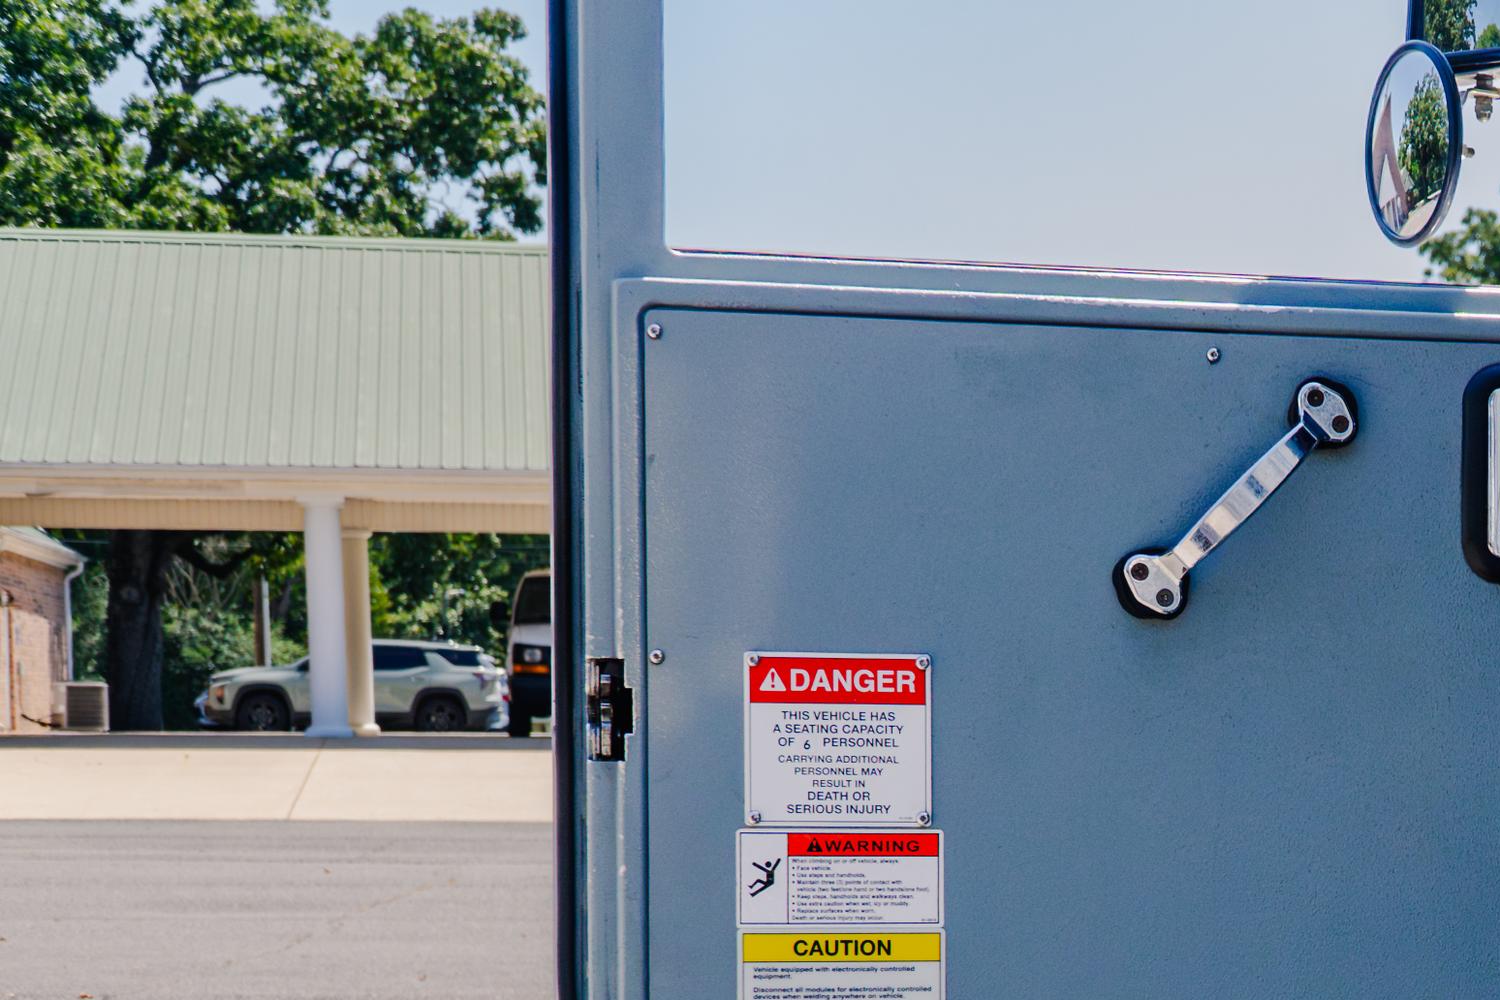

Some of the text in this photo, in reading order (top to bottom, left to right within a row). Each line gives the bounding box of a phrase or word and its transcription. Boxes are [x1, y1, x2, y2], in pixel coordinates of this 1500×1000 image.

[790, 668, 916, 693] DANGER
[782, 710, 895, 720] THIS VEHICLE HAS
[773, 725, 904, 734] A SEATING CAPACITY
[778, 737, 899, 750] OF 6 PERSONNEL
[778, 755, 899, 764] CARRYING ADDITIONAL
[808, 792, 870, 800] DEATH OR
[787, 805, 891, 814] SERIOUS INJURY
[825, 840, 920, 852] WARNING
[793, 939, 891, 956] CAUTION
